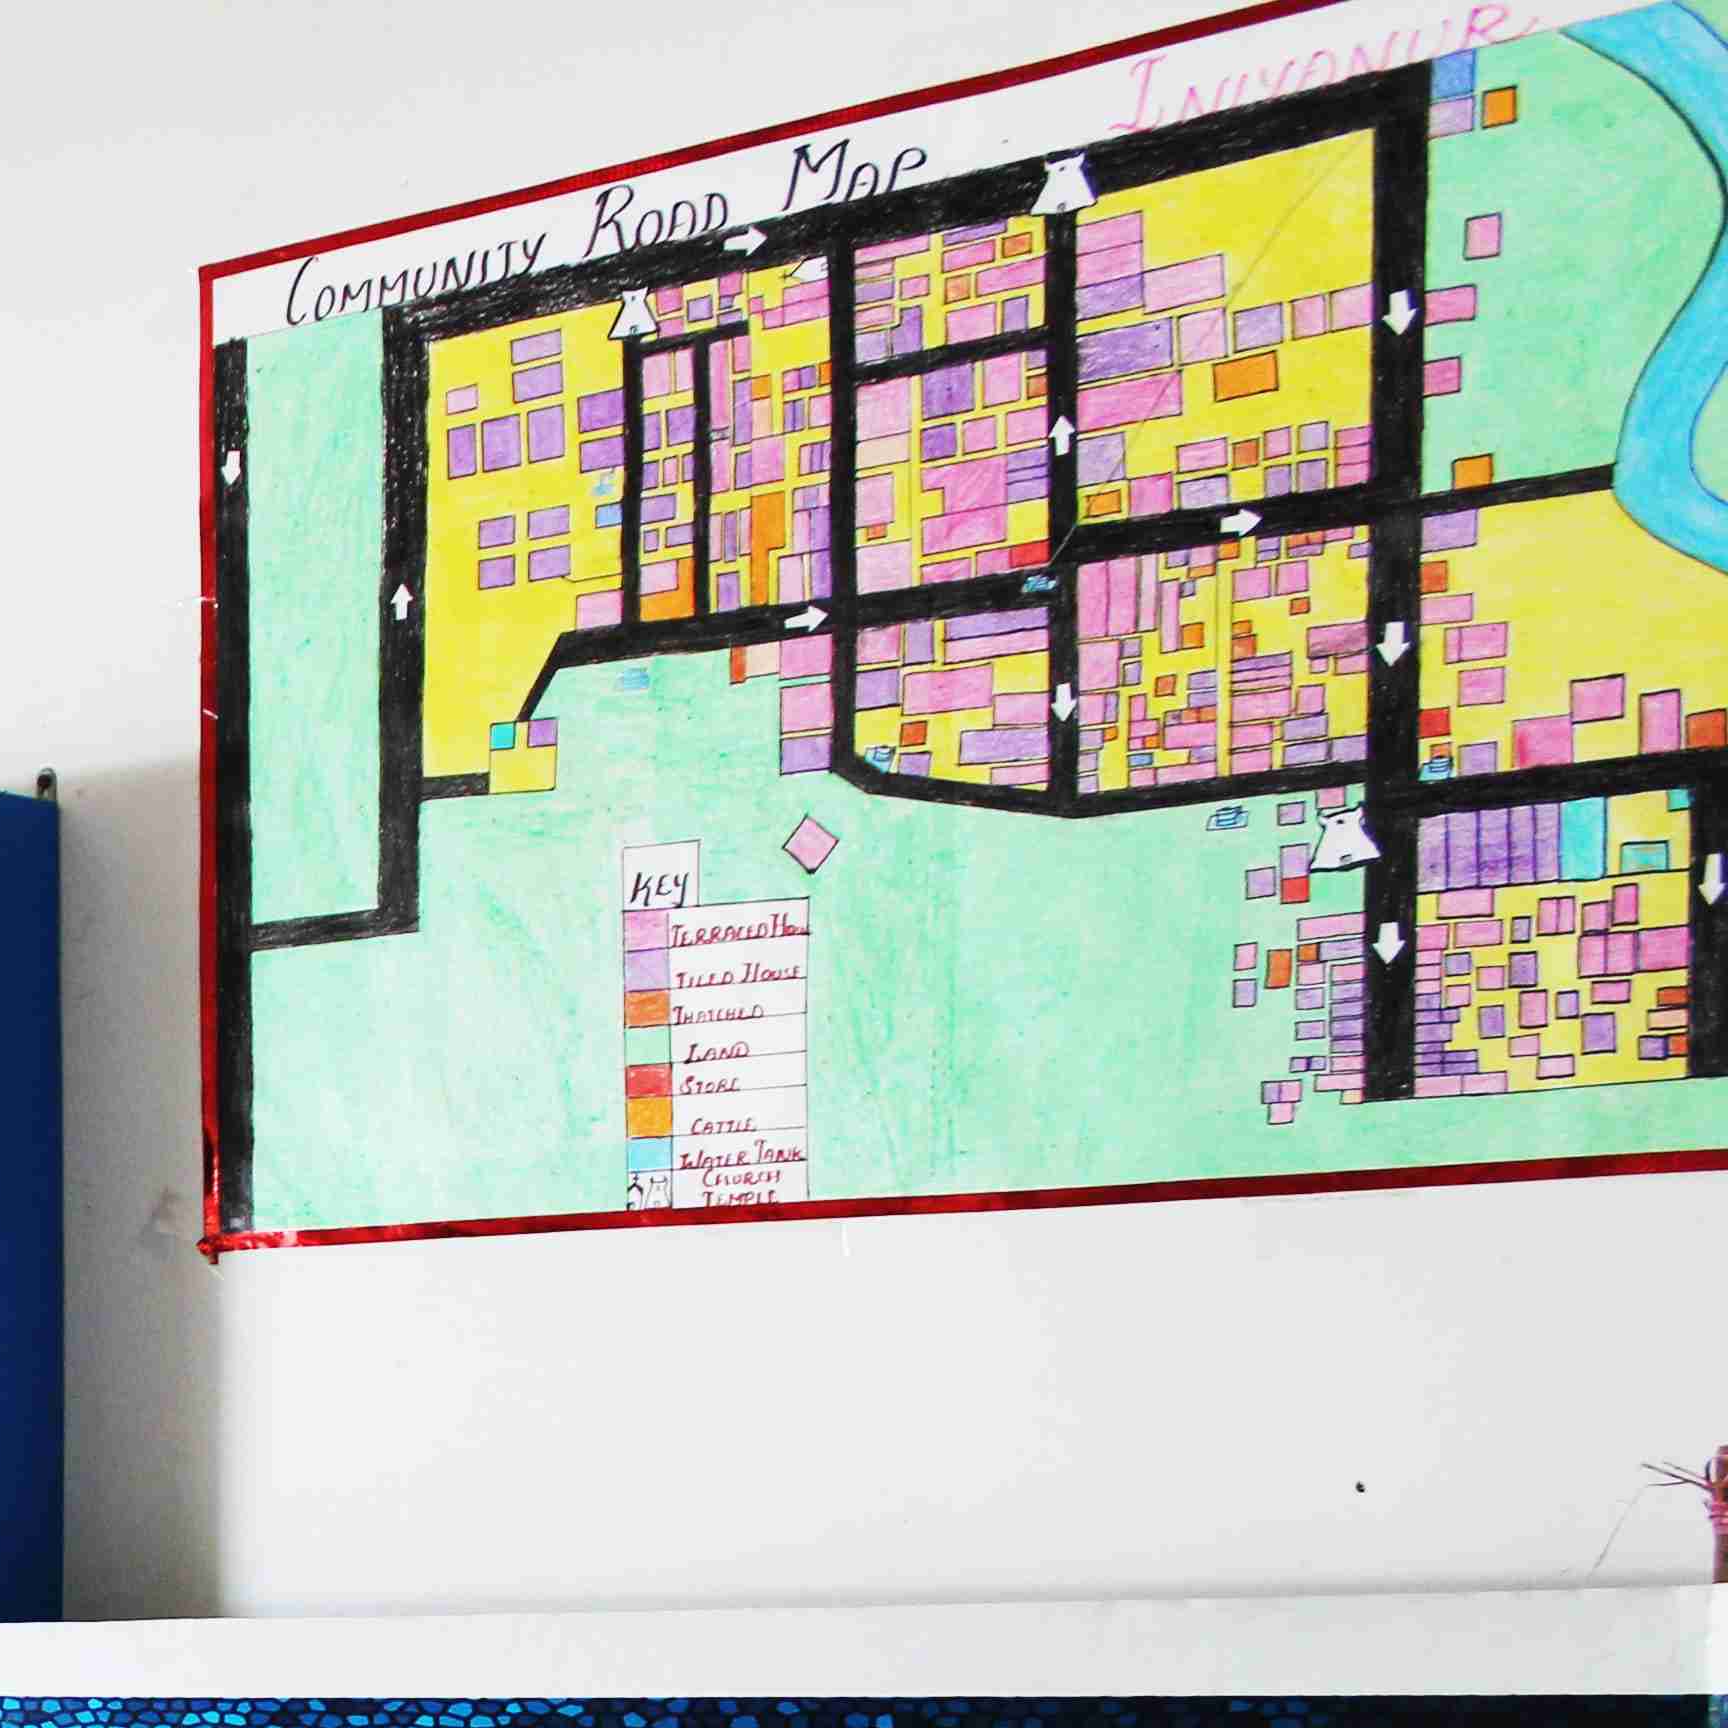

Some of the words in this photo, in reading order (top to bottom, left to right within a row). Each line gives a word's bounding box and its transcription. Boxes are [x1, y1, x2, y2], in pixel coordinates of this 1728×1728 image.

[286, 232, 548, 327] COMMUNITY
[582, 182, 730, 260] ROAD
[780, 137, 928, 211] MAP
[630, 870, 690, 907] KEY
[671, 1004, 765, 1026] THATCHED
[683, 1040, 751, 1064] LAND
[679, 1074, 742, 1096] STORE
[689, 1117, 757, 1136] CATTLE
[679, 1147, 755, 1170] WATER
[701, 1168, 782, 1188] CHURCH
